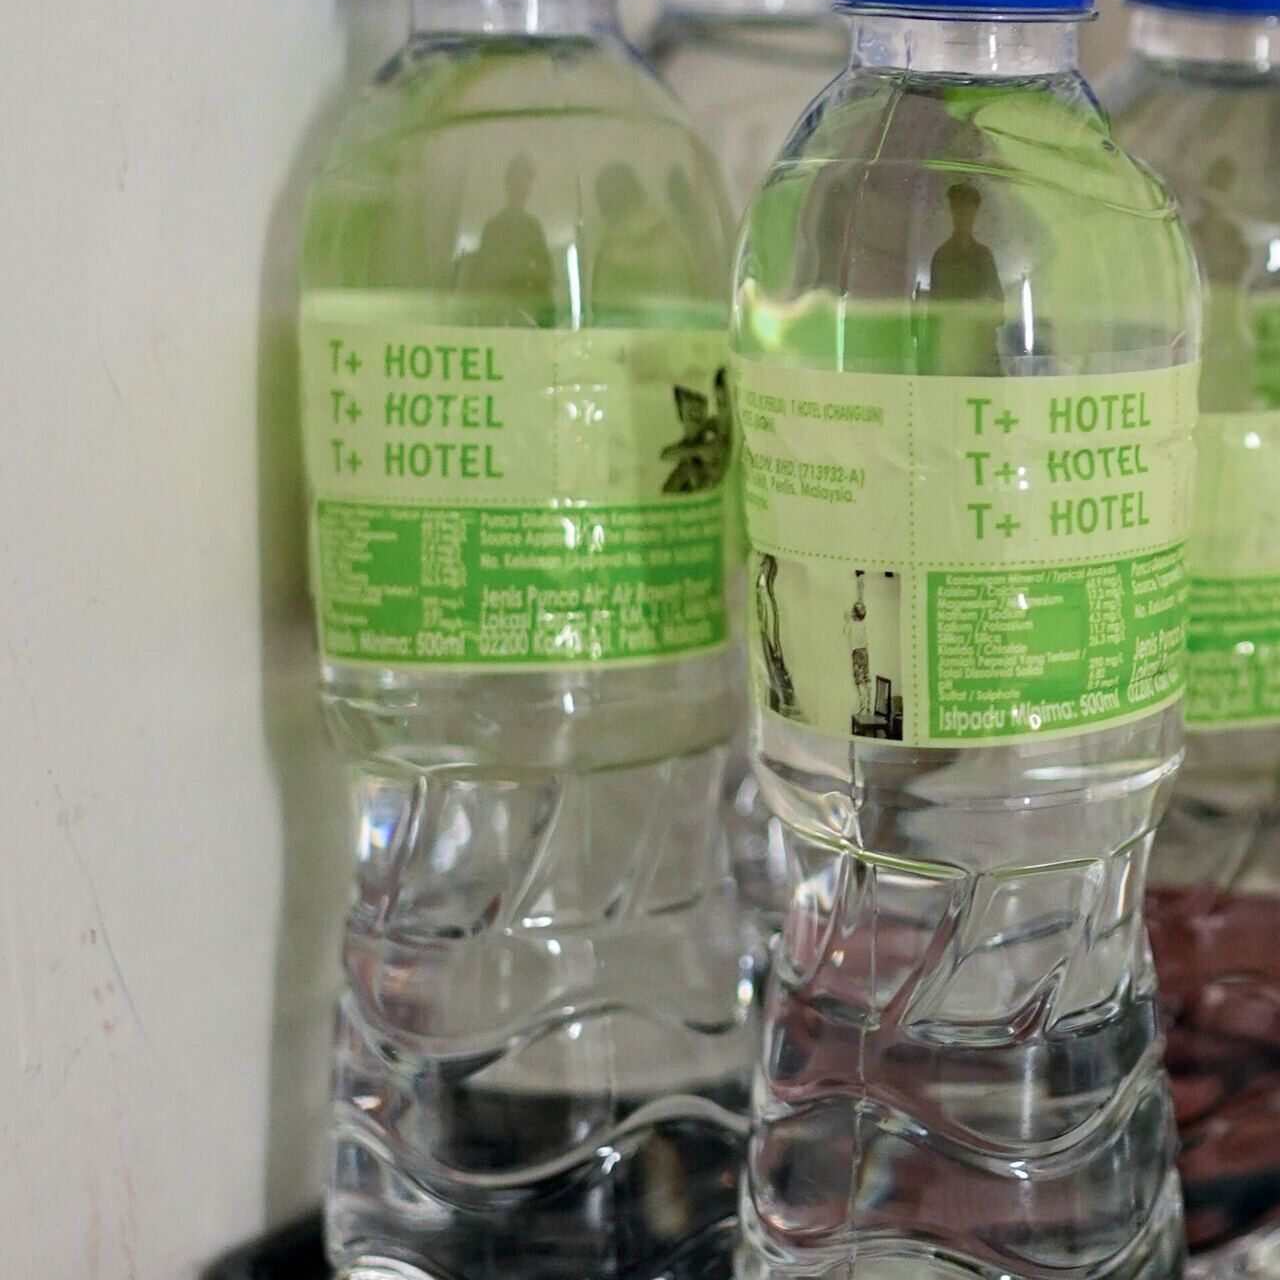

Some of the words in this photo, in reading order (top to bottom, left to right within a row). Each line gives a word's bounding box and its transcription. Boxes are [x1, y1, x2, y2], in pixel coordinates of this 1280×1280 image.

[329, 338, 362, 375] T+
[384, 344, 504, 381] HOTEL
[329, 388, 362, 424] T+
[384, 392, 504, 428] HOTEL
[966, 398, 1020, 435] T+
[1049, 392, 1151, 434] HOTEL
[330, 438, 362, 473] T+
[384, 441, 504, 478] HOTEL
[966, 451, 1019, 486] T+
[1047, 444, 1149, 483] HOTEL
[800, 481, 857, 504] Malaysia.
[967, 503, 1021, 540] T+
[1049, 491, 1150, 536] HOTEL
[1079, 687, 1121, 718] 500ml
